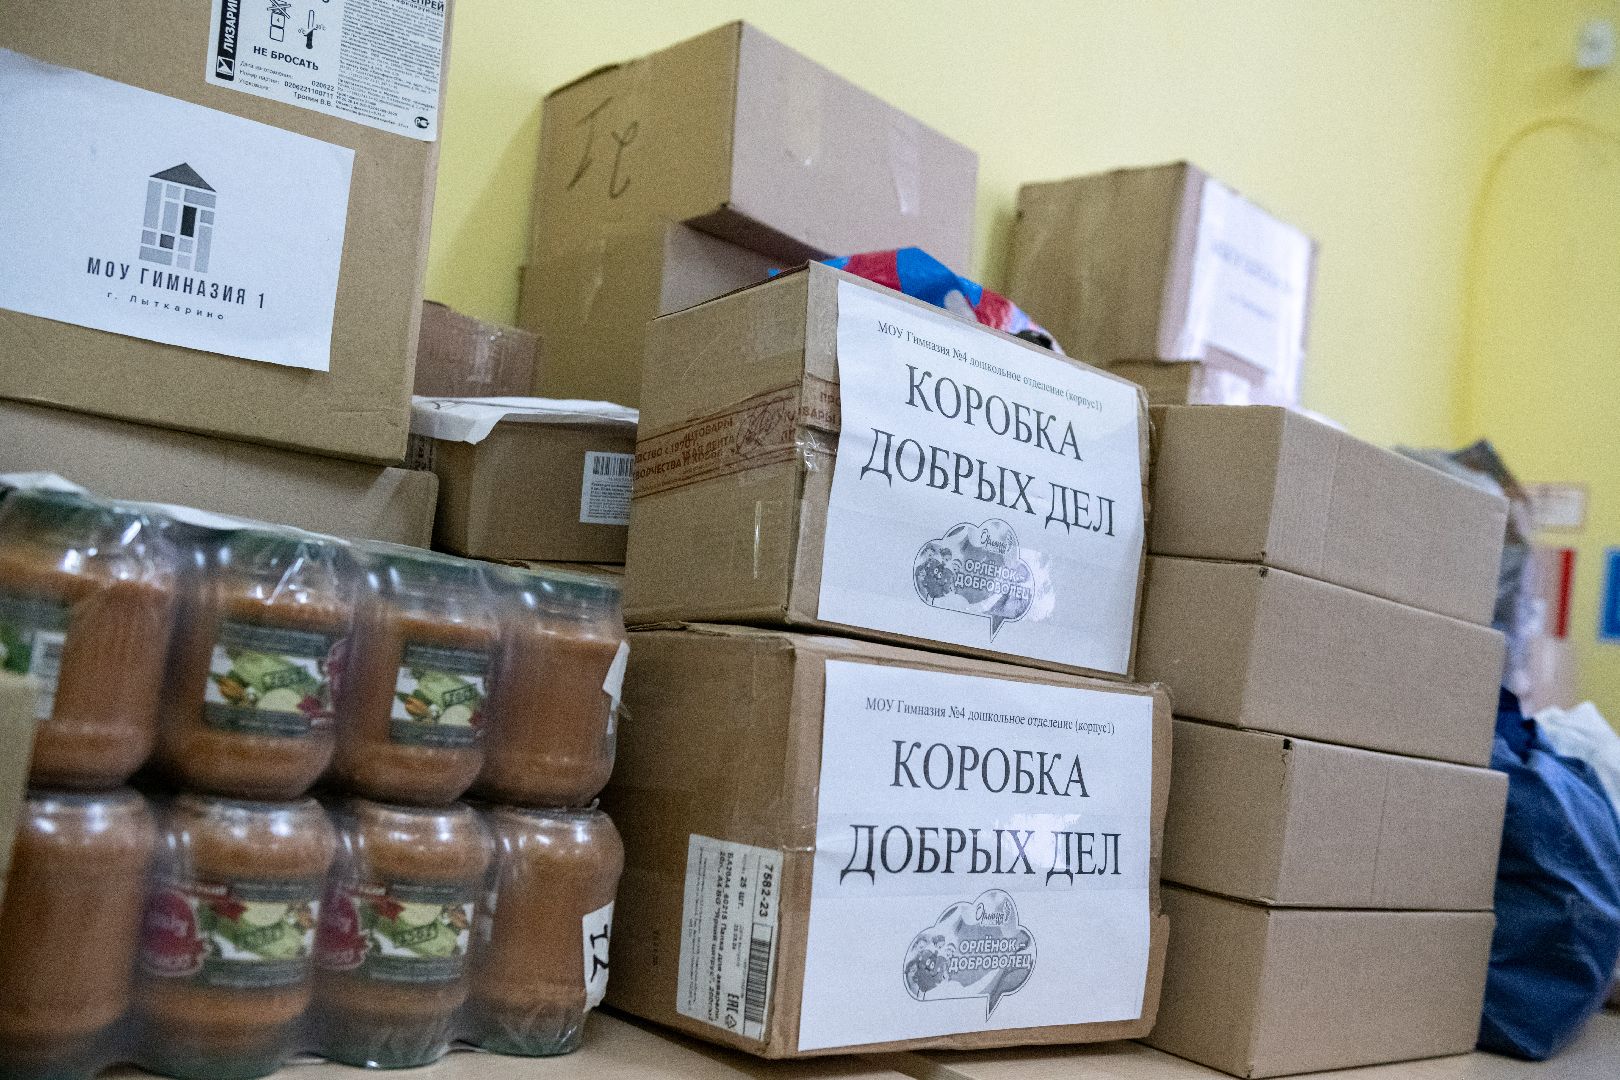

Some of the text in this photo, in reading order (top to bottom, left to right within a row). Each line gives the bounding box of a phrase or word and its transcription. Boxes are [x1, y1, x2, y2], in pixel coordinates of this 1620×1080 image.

[223, 0, 238, 53] ЛИЗАРИ
[253, 46, 319, 71] НЕ БРОСАТЬ
[87, 257, 265, 309] МОУ ГИМНАЗИЯ 1
[107, 292, 224, 321] г. Лыткарино
[877, 320, 903, 339] МОУ
[906, 330, 950, 356] Гимназия
[953, 347, 967, 362] №4
[969, 357, 1021, 382] дошкольное
[1023, 378, 1064, 397] отделение
[905, 364, 1083, 461] КОРОБКА
[860, 428, 1116, 537] ДОБРЫХ ДЕЛ
[955, 573, 1031, 600] ДОБРОВОЛЕЦ
[965, 559, 1016, 582] ОРЛЁНОК
[865, 697, 1115, 736] МОУ Гимназия №4 дошкольное отделение (корпус1)
[890, 740, 1090, 797] КОРОБКА
[840, 824, 1122, 886] ДОБРЫХ ДЕЛ
[737, 890, 745, 910] шт.
[739, 875, 747, 889] 25
[759, 862, 773, 918] 7582-23
[949, 953, 1032, 972] ДОБРОВОЛЕЦ
[959, 935, 1017, 953] ОРЛЁНОК
